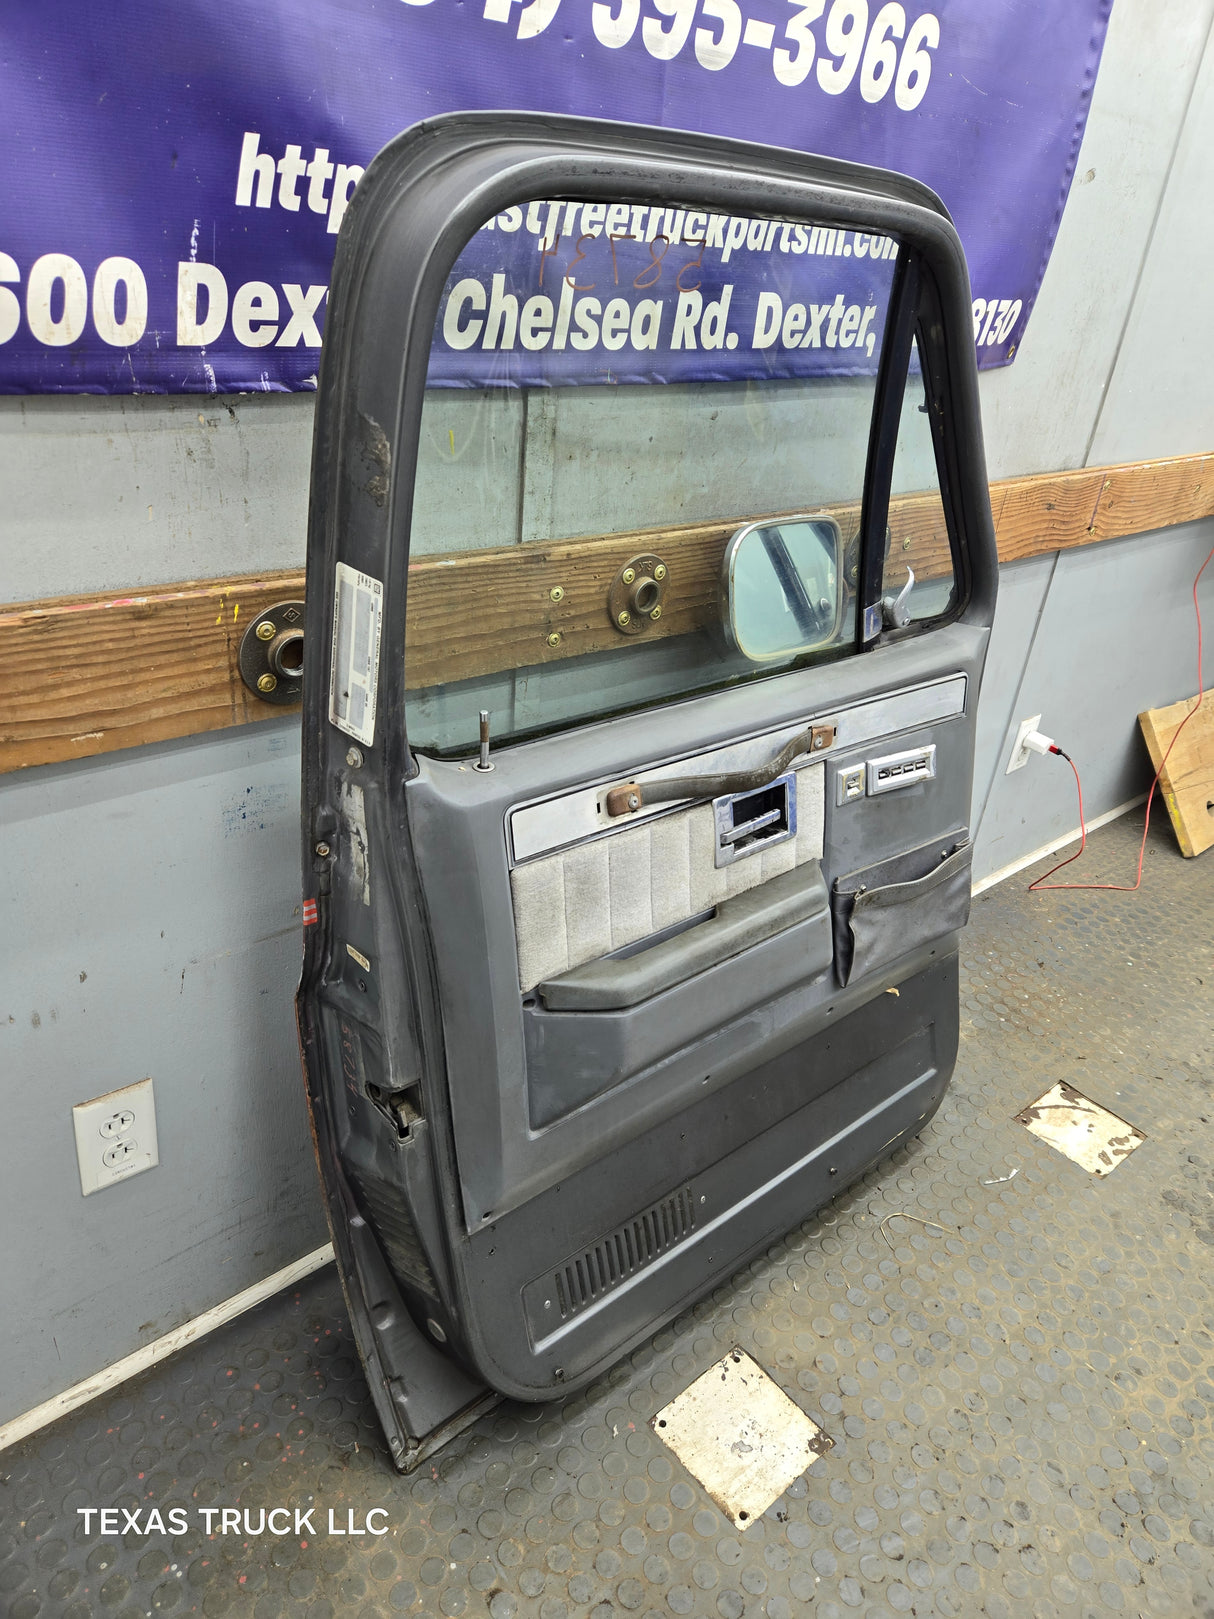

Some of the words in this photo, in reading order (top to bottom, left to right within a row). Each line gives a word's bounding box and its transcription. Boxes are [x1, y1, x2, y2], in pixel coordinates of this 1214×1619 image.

[176, 261, 328, 348] Dex
[442, 273, 664, 351] Chelsea
[670, 284, 739, 351] Rd.
[752, 292, 877, 357] Dexter,
